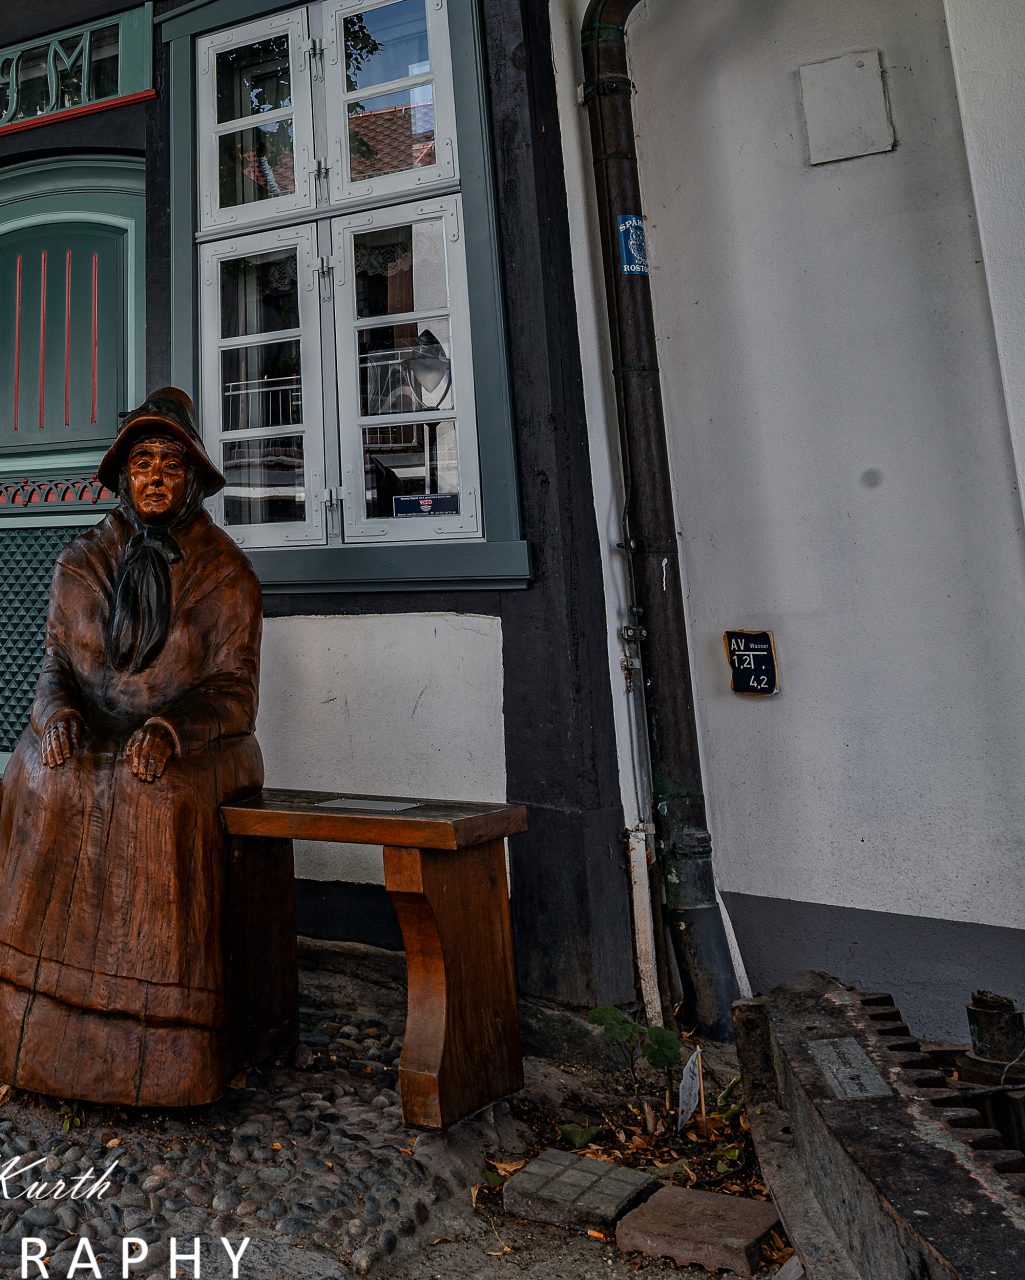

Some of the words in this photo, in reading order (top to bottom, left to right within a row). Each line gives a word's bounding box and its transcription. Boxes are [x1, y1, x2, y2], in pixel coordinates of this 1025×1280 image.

[619, 217, 644, 232] SPÄH
[731, 638, 745, 651] AV
[749, 675, 769, 689] 4,2
